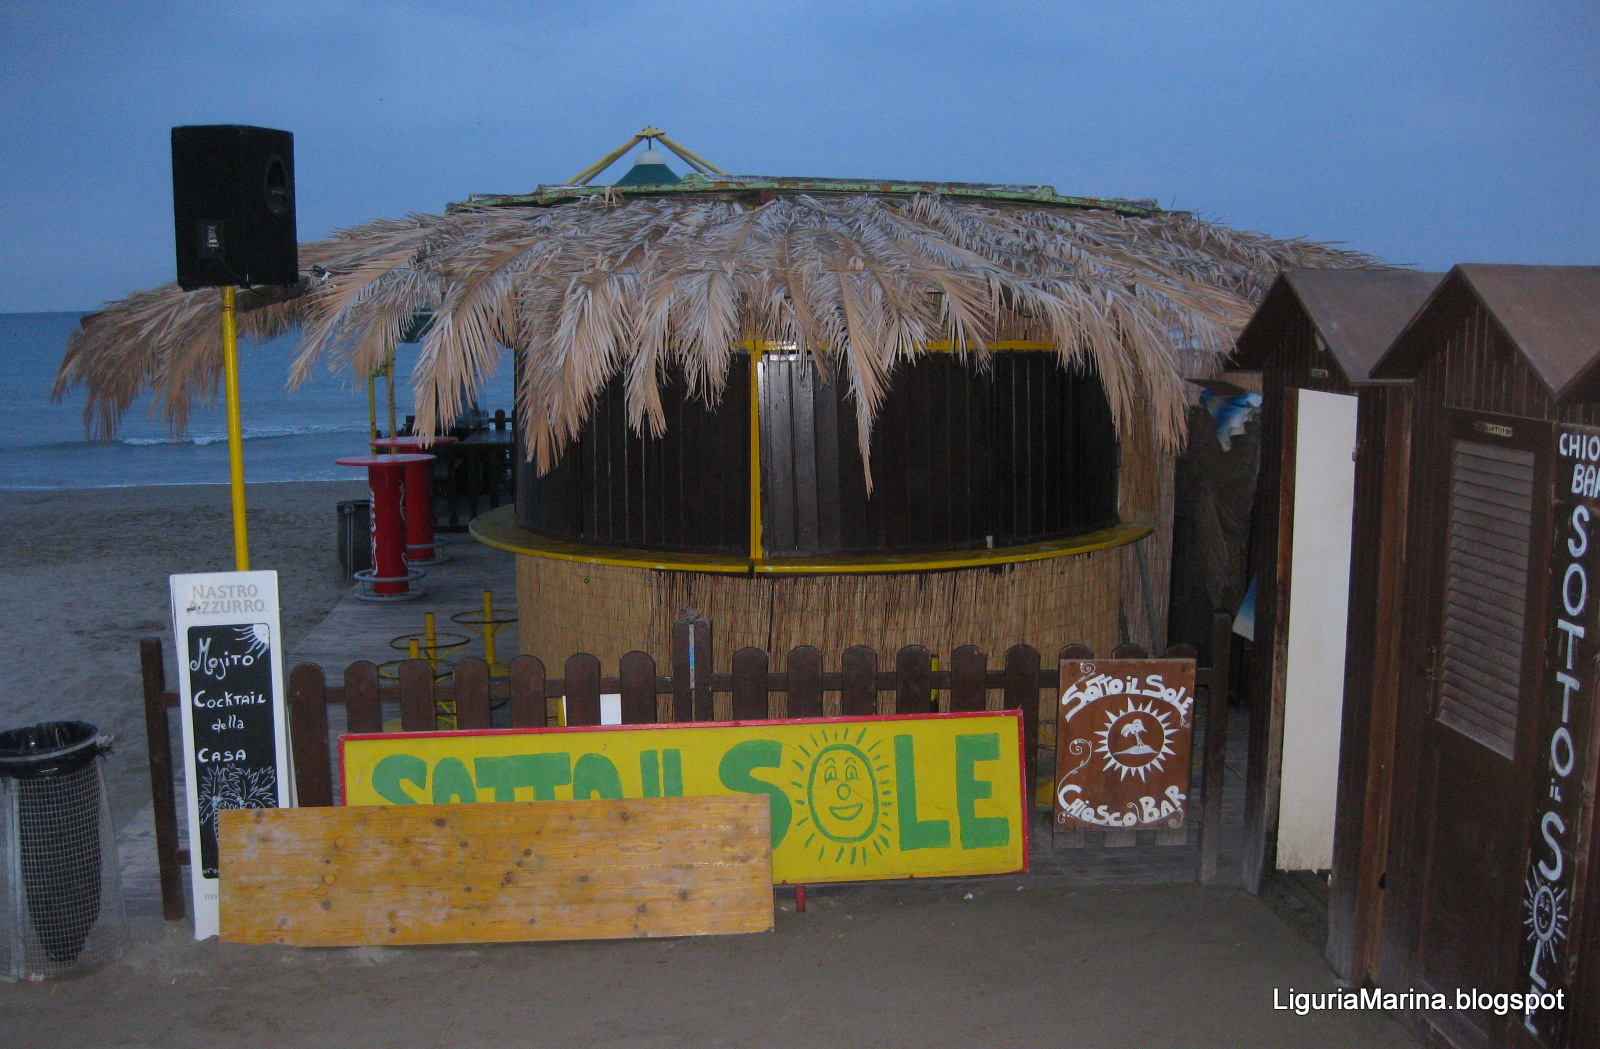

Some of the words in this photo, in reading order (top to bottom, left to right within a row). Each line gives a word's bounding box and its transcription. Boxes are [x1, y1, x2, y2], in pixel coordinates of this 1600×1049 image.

[192, 584, 258, 599] NASTRO
[187, 599, 265, 615] AZZURRO
[1551, 505, 1589, 777] SOTTO
[212, 714, 245, 732] della
[198, 748, 246, 763] CASA
[1139, 785, 1187, 823] BAR
